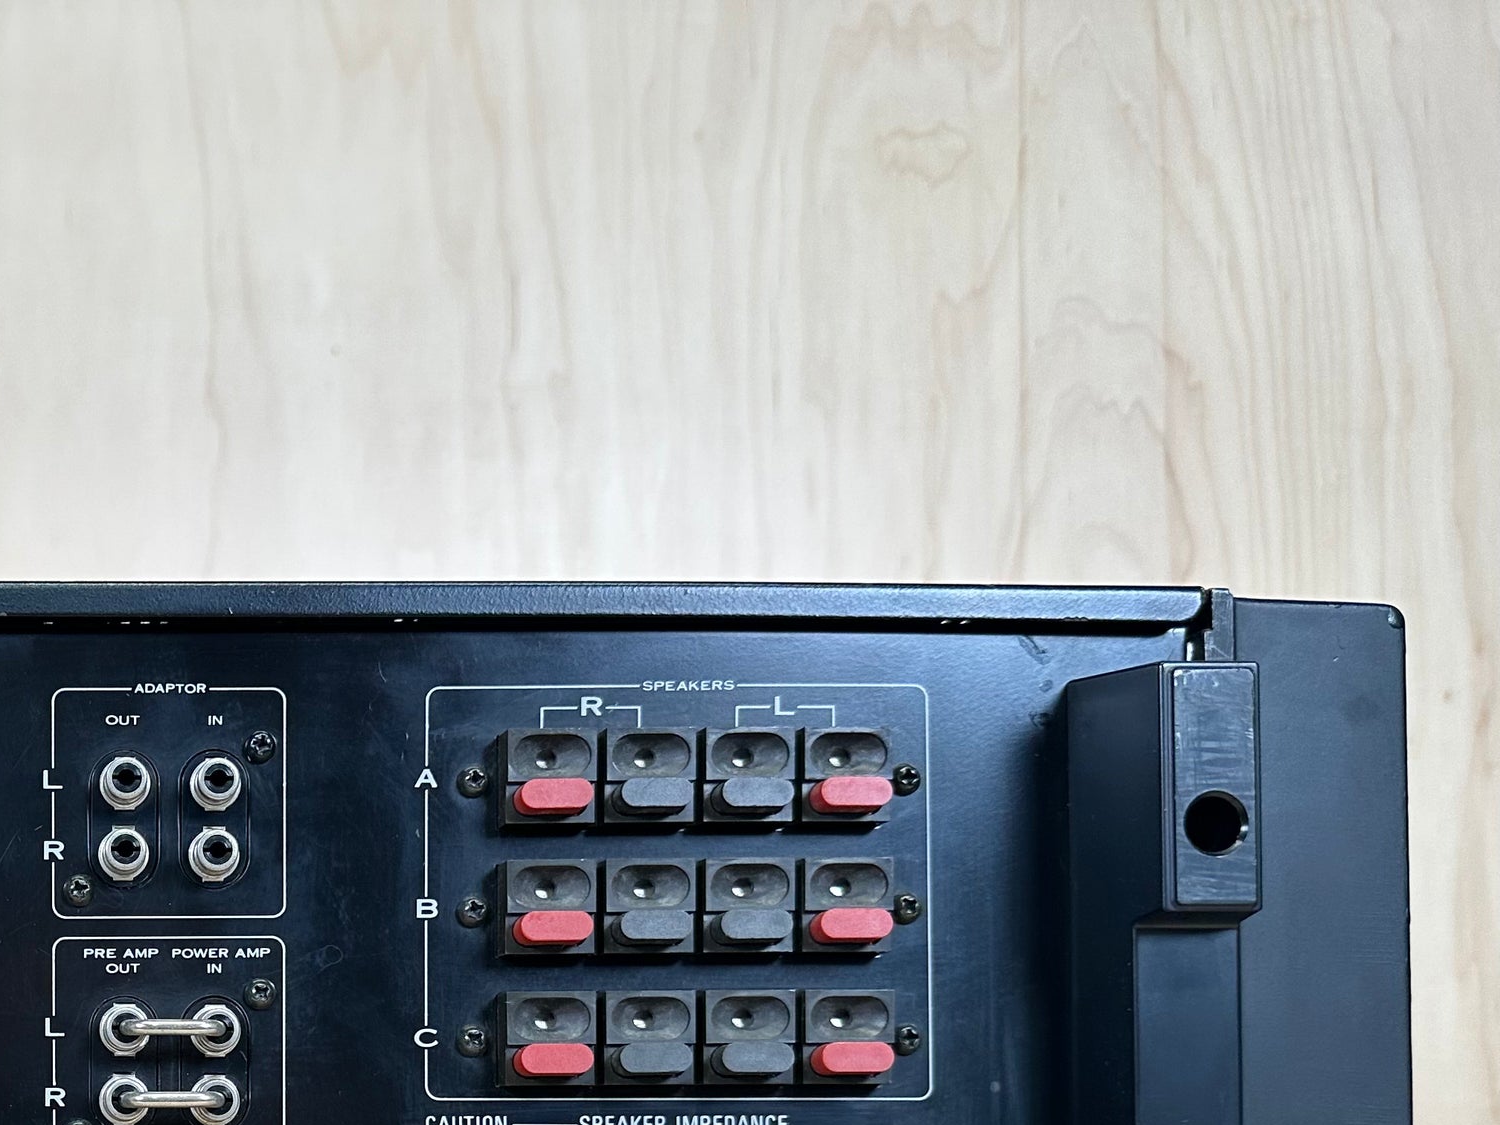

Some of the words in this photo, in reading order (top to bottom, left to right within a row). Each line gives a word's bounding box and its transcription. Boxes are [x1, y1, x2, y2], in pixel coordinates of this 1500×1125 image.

[135, 683, 206, 693] ADAPTOR
[643, 680, 735, 691] SPEAKERS
[581, 696, 603, 716] R
[775, 696, 795, 715] L
[106, 715, 140, 725] OUT
[208, 716, 222, 725] IN
[43, 770, 63, 789] L
[415, 769, 437, 791] A
[44, 841, 64, 860] R
[417, 899, 438, 918] B
[84, 949, 116, 958] PRE
[123, 948, 159, 958] AMP
[172, 948, 228, 958] POWER
[235, 948, 270, 958] AMP
[106, 963, 140, 973] OUT
[207, 963, 221, 973] IN
[45, 1018, 65, 1036] L
[414, 1029, 438, 1050] C
[45, 1088, 65, 1106] R
